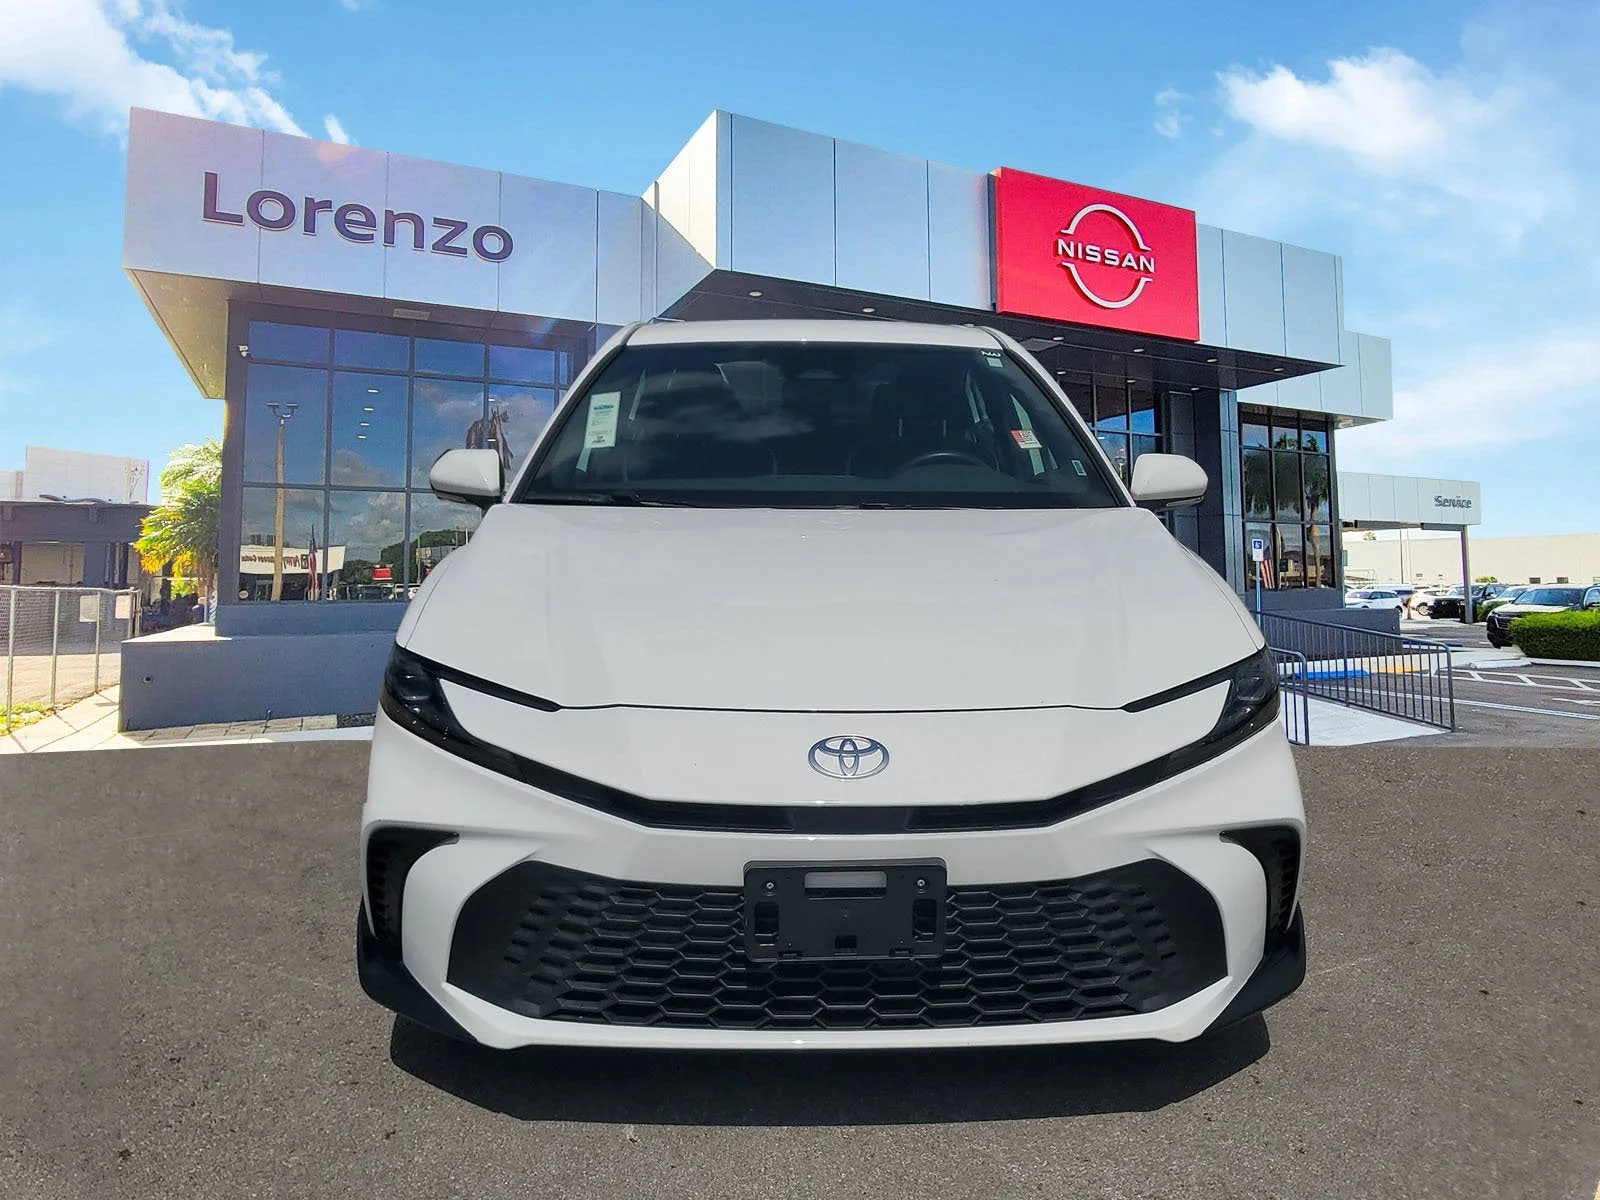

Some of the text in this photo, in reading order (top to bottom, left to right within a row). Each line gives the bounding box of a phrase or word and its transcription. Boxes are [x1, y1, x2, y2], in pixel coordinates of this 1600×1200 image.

[203, 171, 514, 262] Lorenzo
[1057, 238, 1155, 273] NISSAN
[1433, 495, 1472, 509] Service
